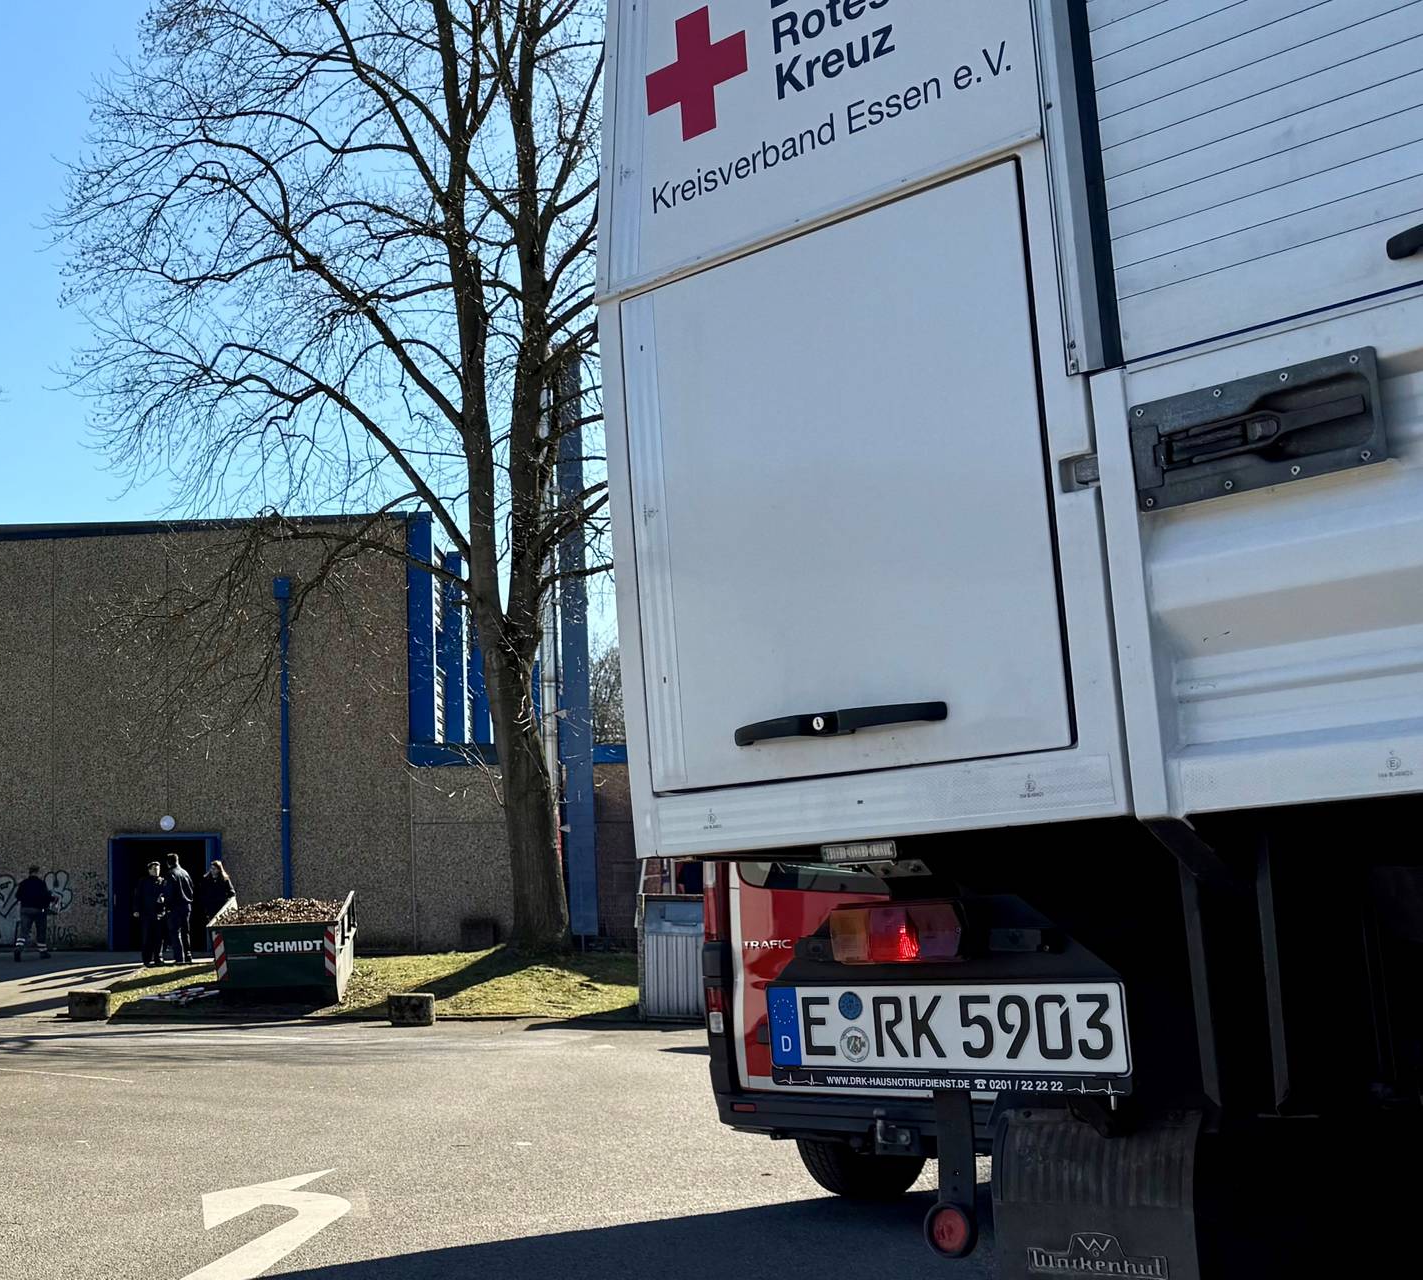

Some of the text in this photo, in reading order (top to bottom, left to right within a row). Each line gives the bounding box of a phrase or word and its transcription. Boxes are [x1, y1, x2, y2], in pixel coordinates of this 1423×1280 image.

[775, 24, 896, 101] Kreuz
[652, 40, 1012, 214] Kreisverband Essen e.V.
[253, 940, 323, 953] SCHMIDT
[744, 939, 793, 949] TRAFIC
[801, 993, 1114, 1060] E RK 5903
[781, 1035, 793, 1052] D
[826, 1076, 971, 1089] WWW.DRK-HAUSNOTRUFDIENST.DE
[989, 1079, 1012, 1090] 0201
[1021, 1080, 1034, 1091] 22
[1035, 1081, 1048, 1091] 22
[1050, 1081, 1064, 1092] 22
